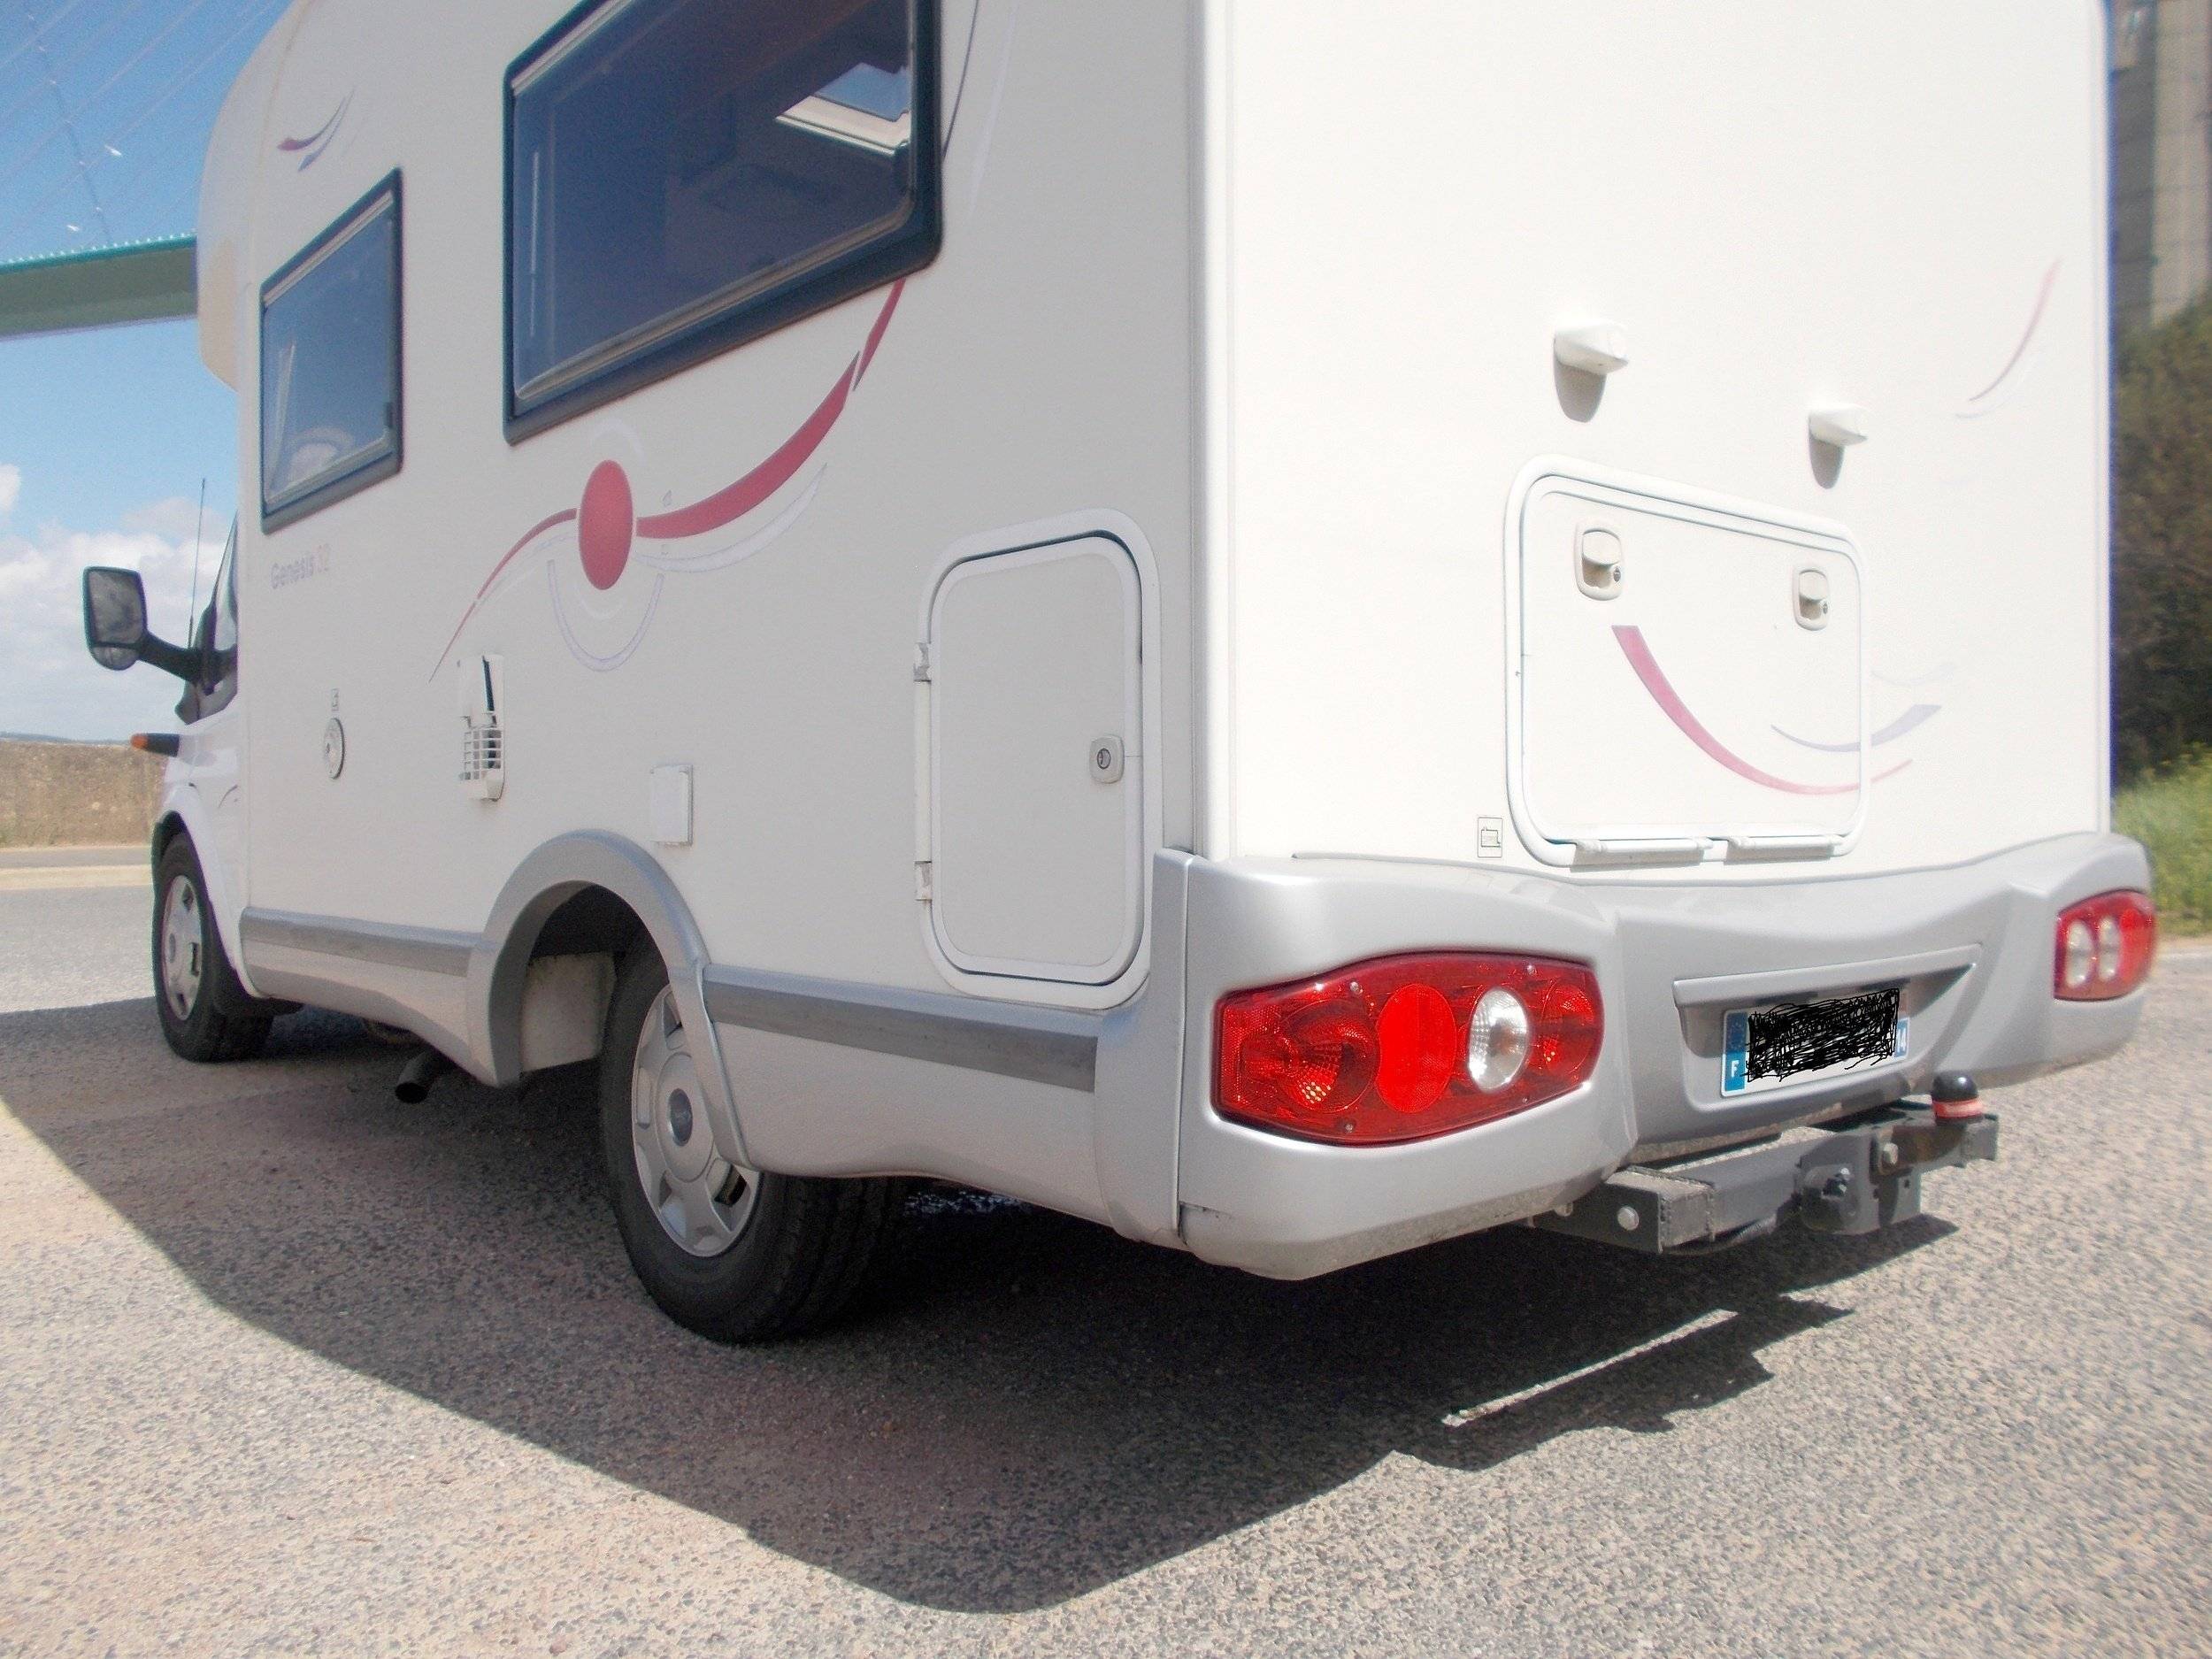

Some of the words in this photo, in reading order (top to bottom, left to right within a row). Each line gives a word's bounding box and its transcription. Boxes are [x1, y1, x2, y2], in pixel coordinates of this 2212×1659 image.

[270, 552, 314, 589] Genesis
[1896, 1027, 1907, 1053] 14
[1731, 1059, 1740, 1079] F
